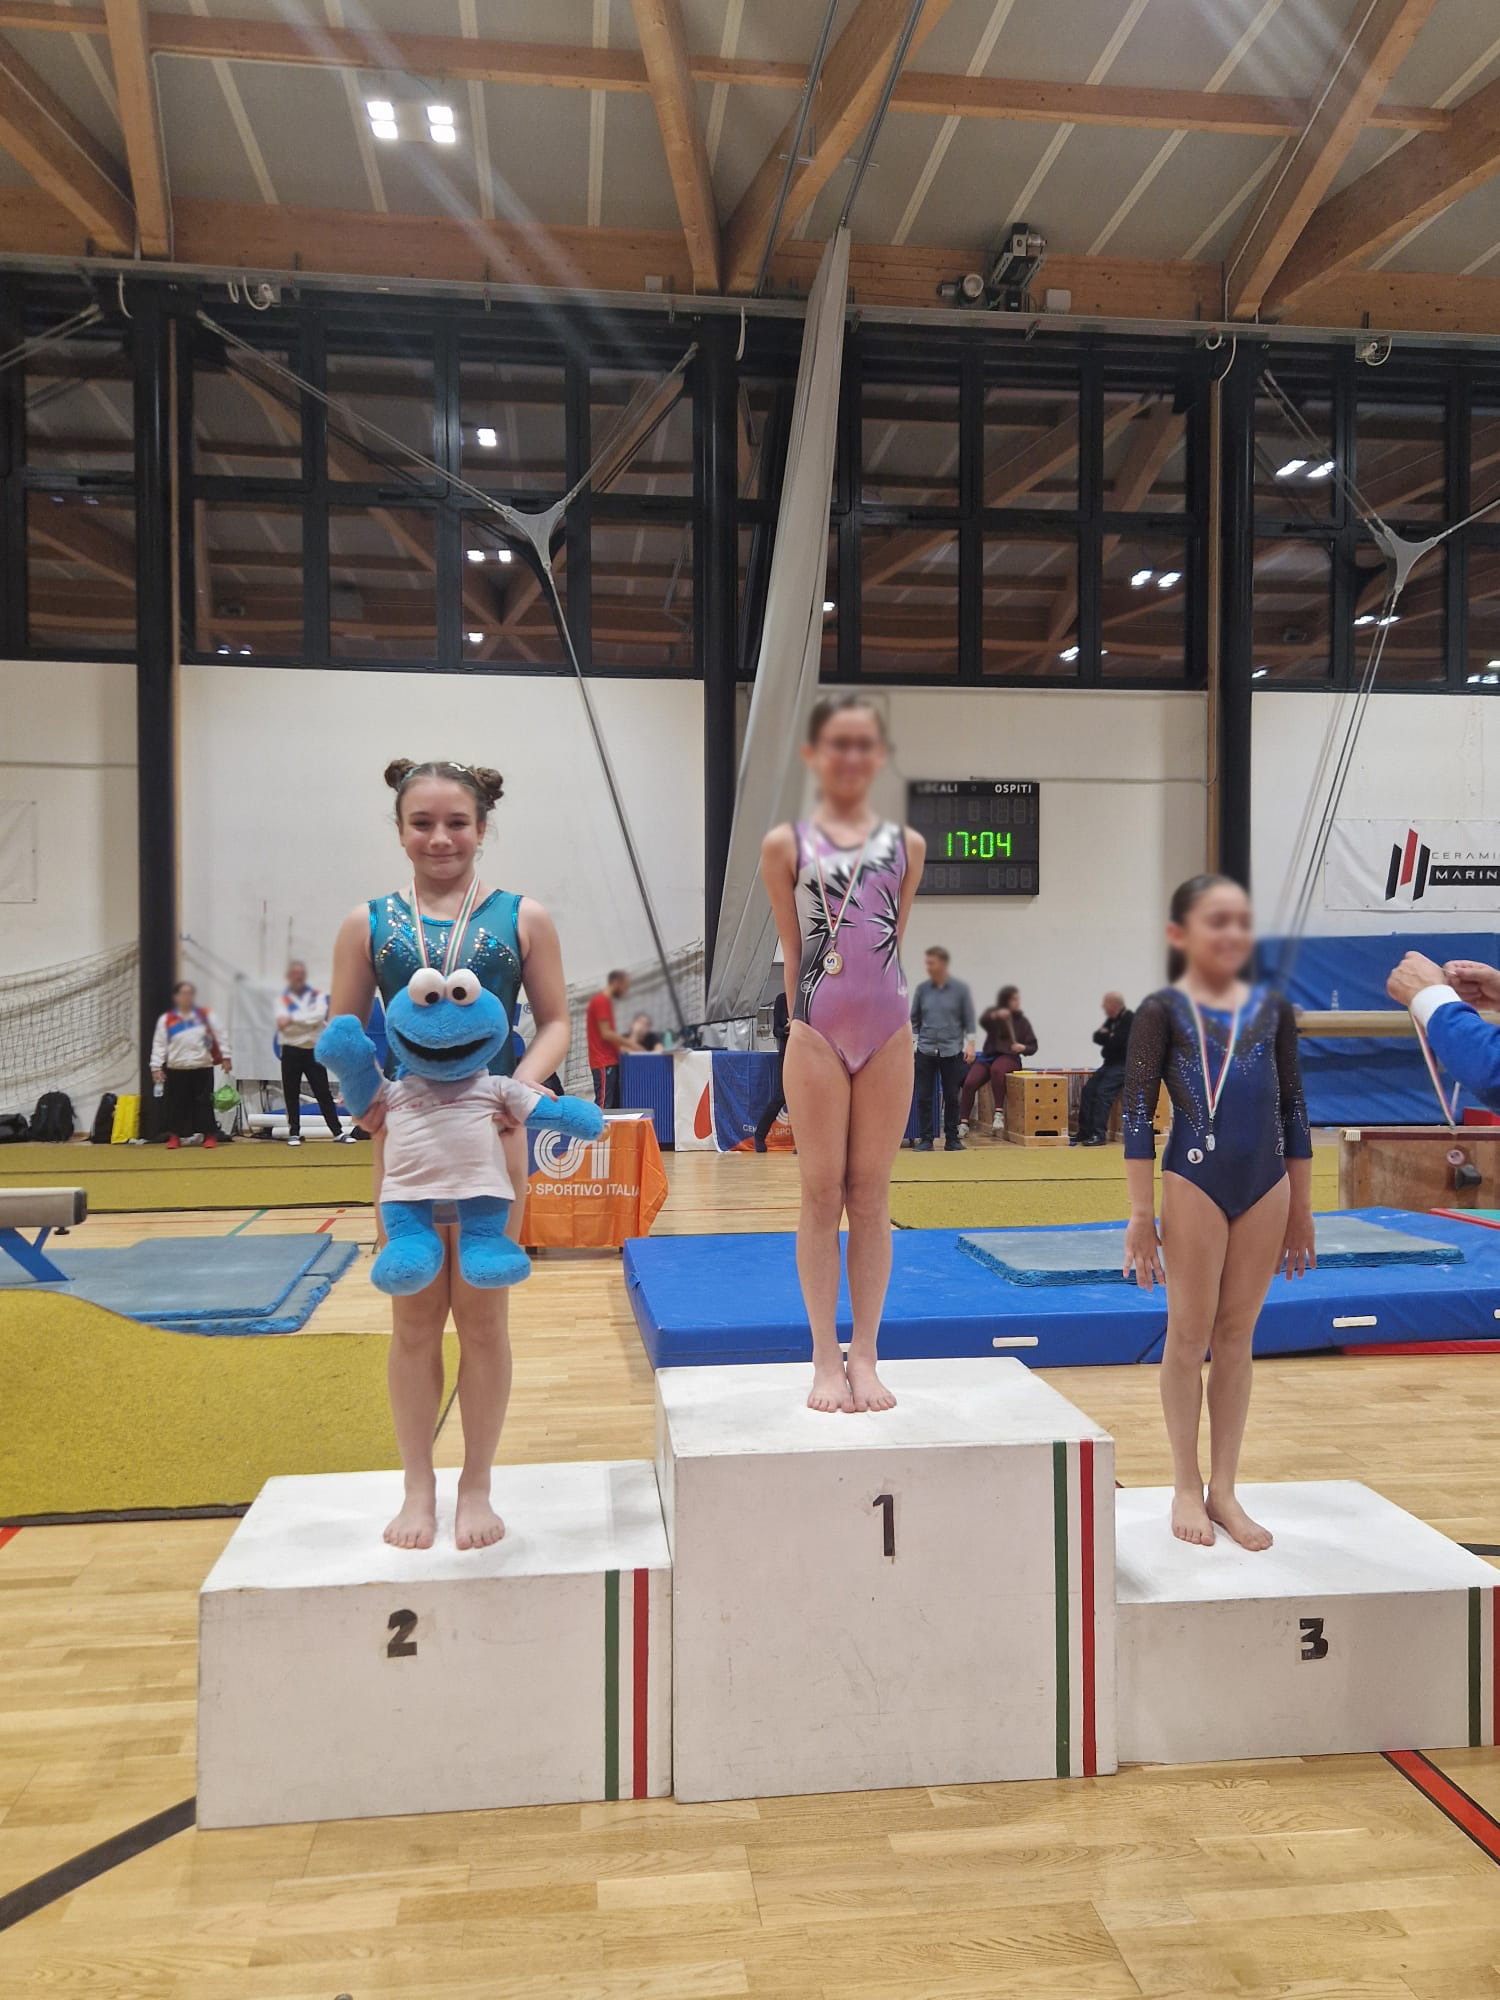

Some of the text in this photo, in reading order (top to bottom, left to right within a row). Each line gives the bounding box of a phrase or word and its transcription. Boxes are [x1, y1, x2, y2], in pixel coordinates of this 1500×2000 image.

[994, 784, 1032, 794] OSPITI
[947, 831, 1012, 858] 17:04
[1431, 852, 1500, 860] CERAMI
[535, 1183, 603, 1197] SPORTIVO
[872, 1494, 896, 1557] 1
[387, 1608, 419, 1658] 2
[1299, 1617, 1329, 1660] 3
